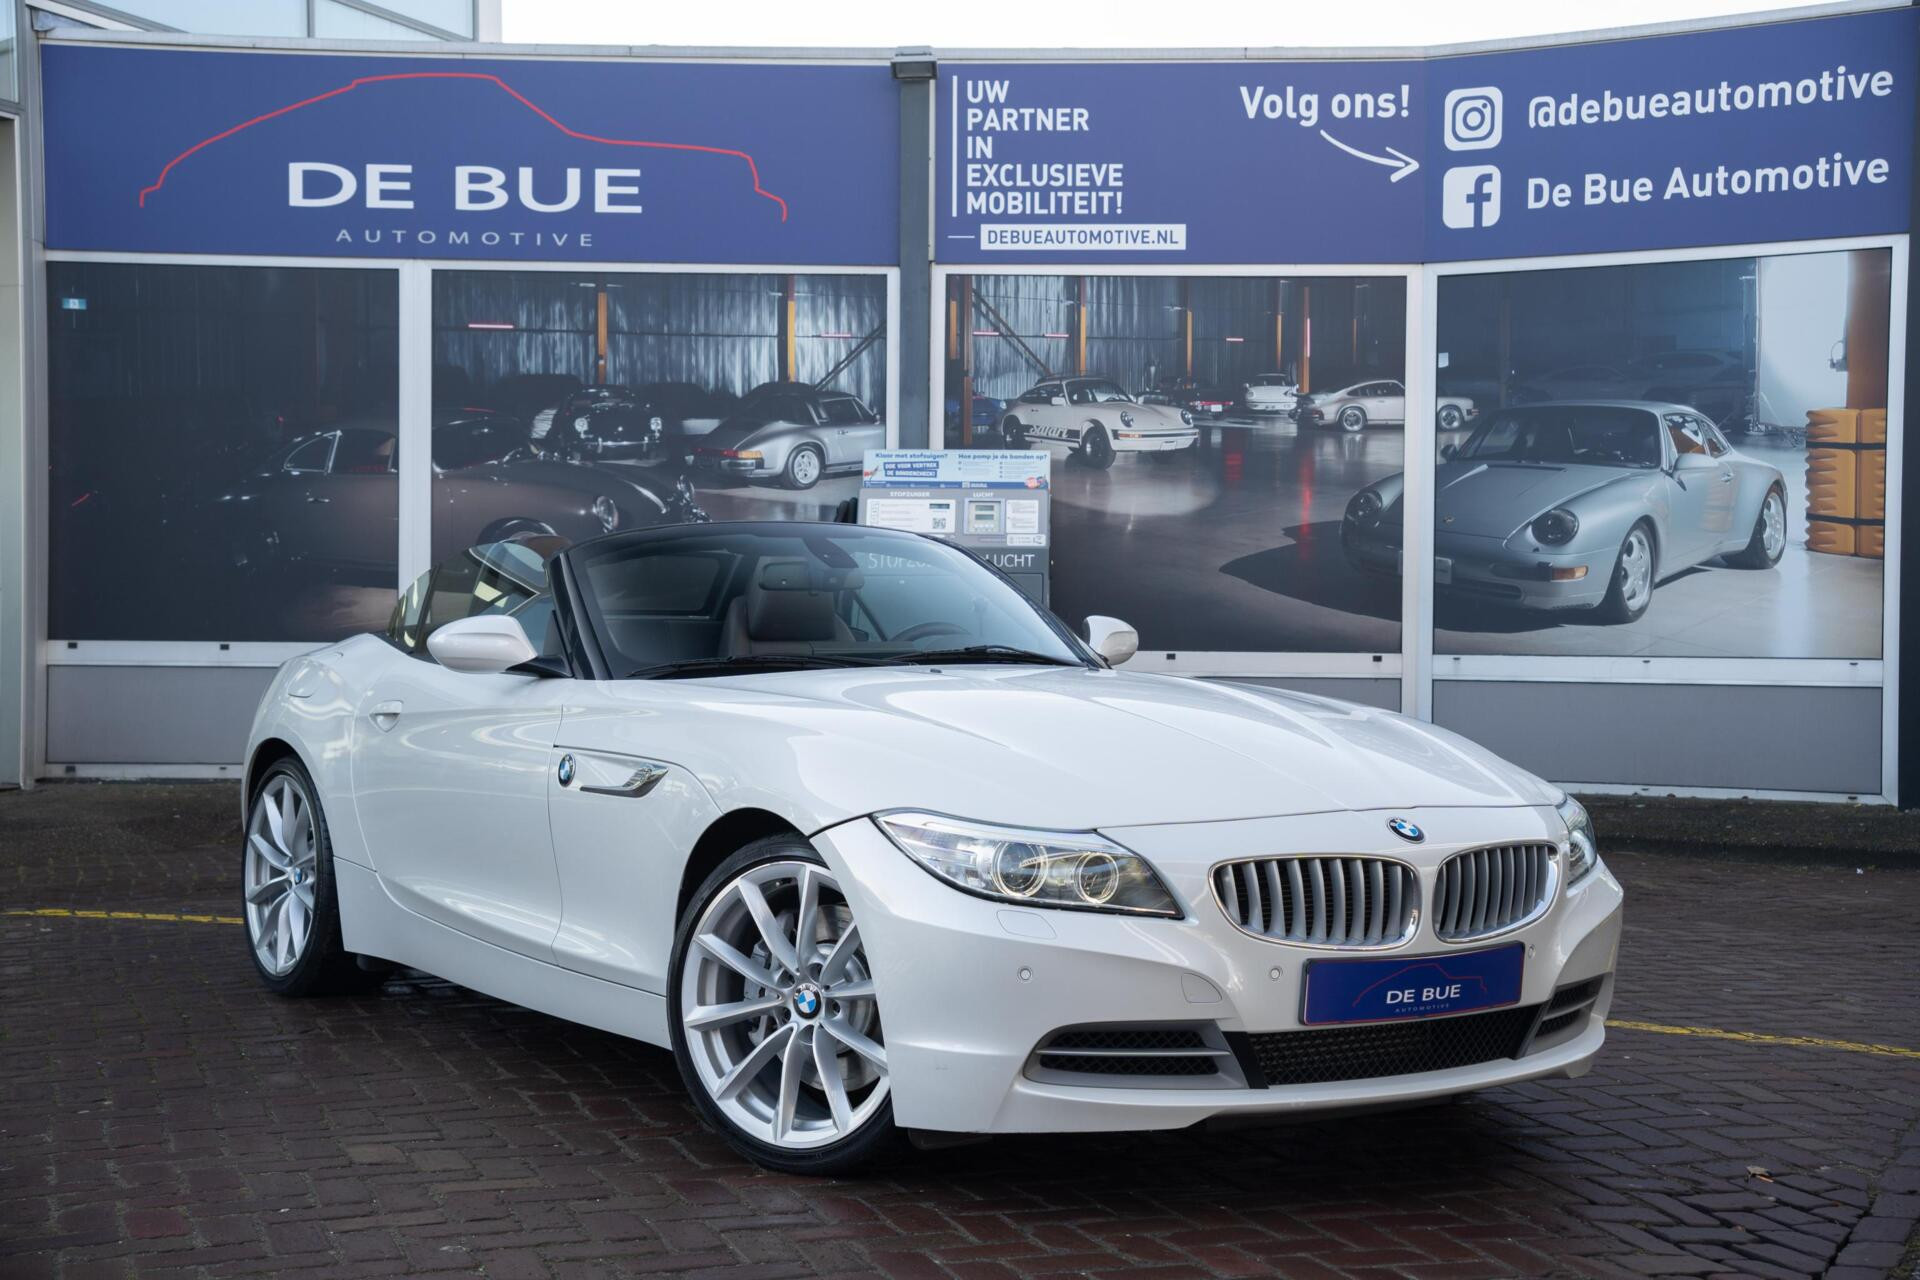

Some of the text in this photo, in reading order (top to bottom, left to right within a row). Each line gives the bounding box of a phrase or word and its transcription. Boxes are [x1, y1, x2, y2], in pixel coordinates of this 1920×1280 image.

[967, 80, 1010, 104] UW
[1528, 65, 1893, 129] @debueautomotive
[1239, 84, 1410, 127] Volg ons!
[967, 107, 1089, 132] PARTNER
[967, 136, 993, 159] IN
[967, 163, 1124, 187] EXCLUSIEVE
[1527, 153, 1889, 209] De Bue Automotive
[288, 161, 642, 214] DE BUE
[966, 191, 1123, 215] MOBILITEIT!
[336, 229, 594, 248] AUTOMOTIVE
[987, 229, 1179, 245] DEBUEAUTOMOTIVE.NL
[1386, 984, 1462, 1004] DE BUE
[1394, 1003, 1450, 1014] AUTOMOTIVE
